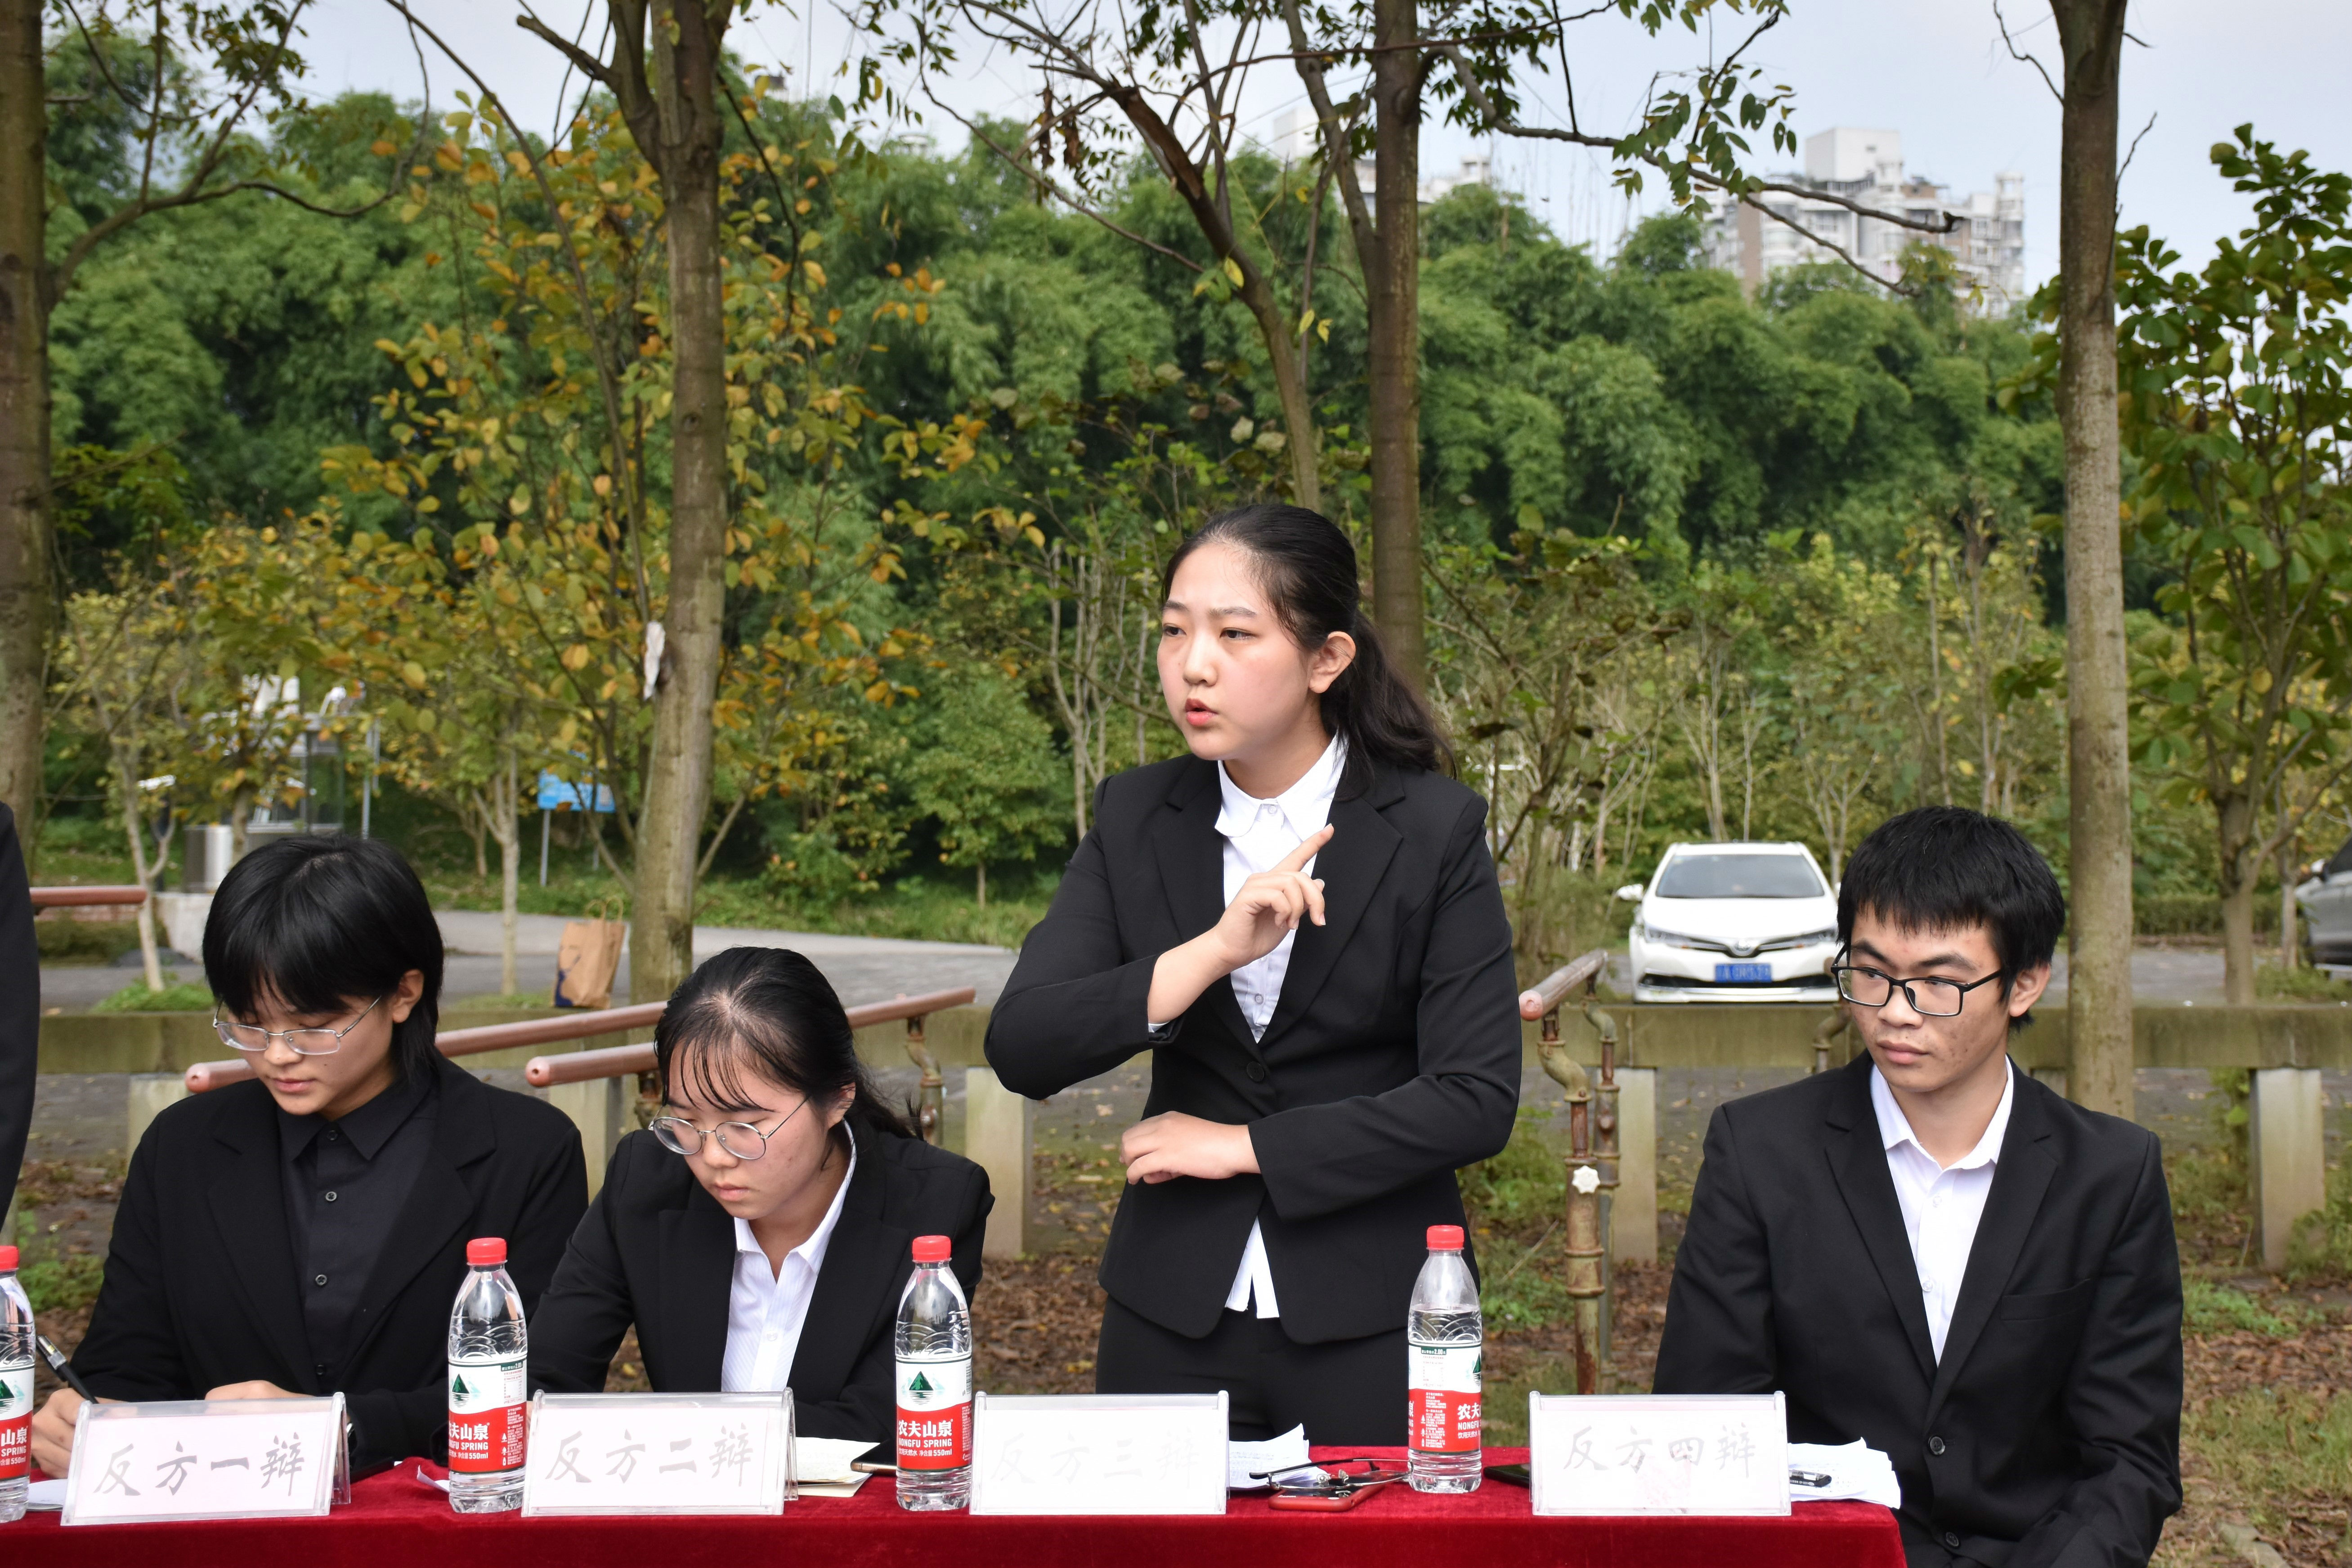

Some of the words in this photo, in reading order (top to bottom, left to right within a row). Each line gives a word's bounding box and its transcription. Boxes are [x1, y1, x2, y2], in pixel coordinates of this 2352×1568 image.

[1457, 1402, 1481, 1420] 农夫
[899, 1420, 952, 1438] 农夫山泉
[1458, 1420, 1479, 1430] NONGFU
[1, 1427, 27, 1447] 山泉
[899, 1438, 921, 1448] NONGFU
[923, 1438, 952, 1447] SPRING
[1, 1445, 27, 1457] SPRING
[461, 1442, 488, 1451] SPRING
[545, 1422, 753, 1487] 反方二辩
[1563, 1422, 1756, 1479] 反方四辩
[0, 1456, 26, 1465] 含量550ml
[93, 1432, 305, 1497] 反方一辩
